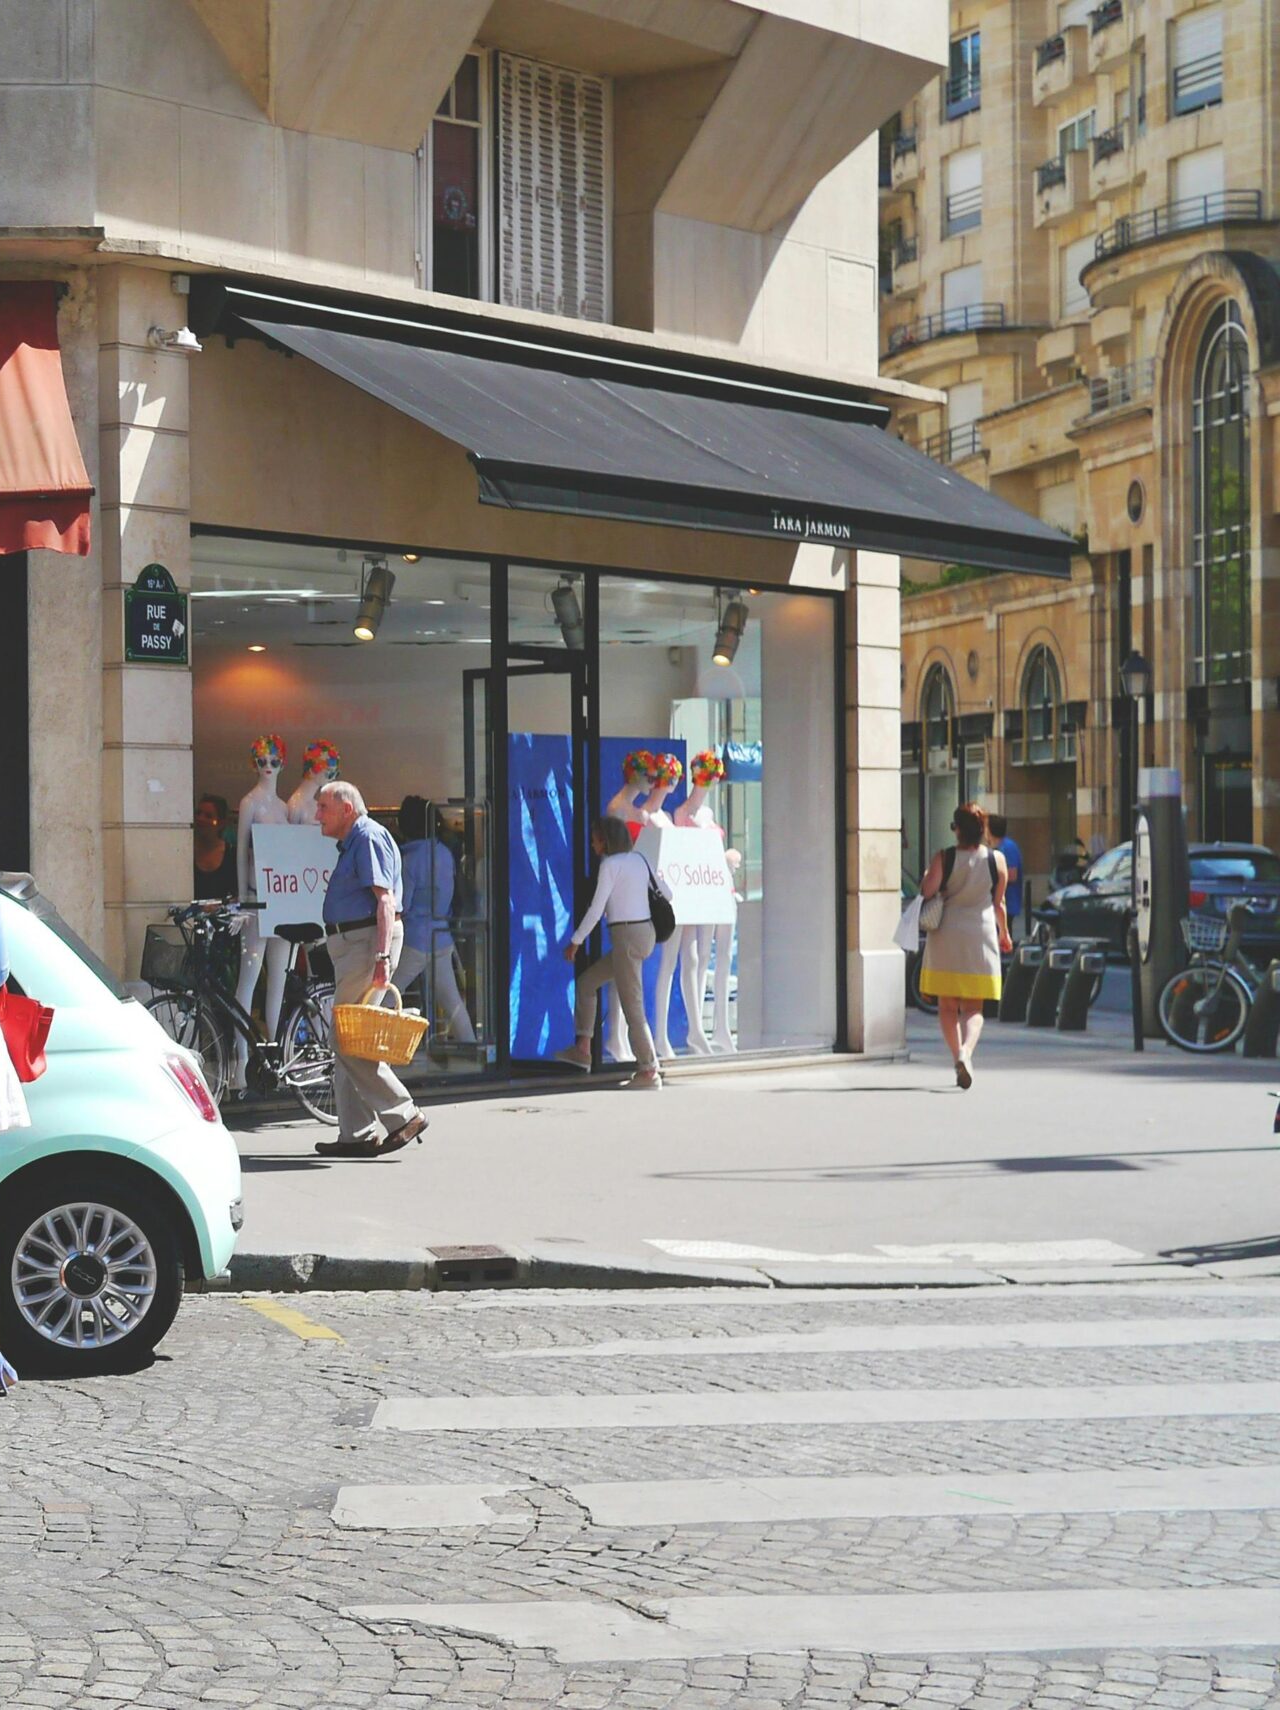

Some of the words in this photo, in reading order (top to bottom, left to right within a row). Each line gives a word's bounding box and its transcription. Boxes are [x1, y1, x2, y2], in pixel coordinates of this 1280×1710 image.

[147, 604, 166, 620] RUE
[152, 622, 161, 631] DE
[141, 634, 173, 650] PASSY
[262, 867, 298, 894] Tara
[684, 864, 725, 887] Soldes
